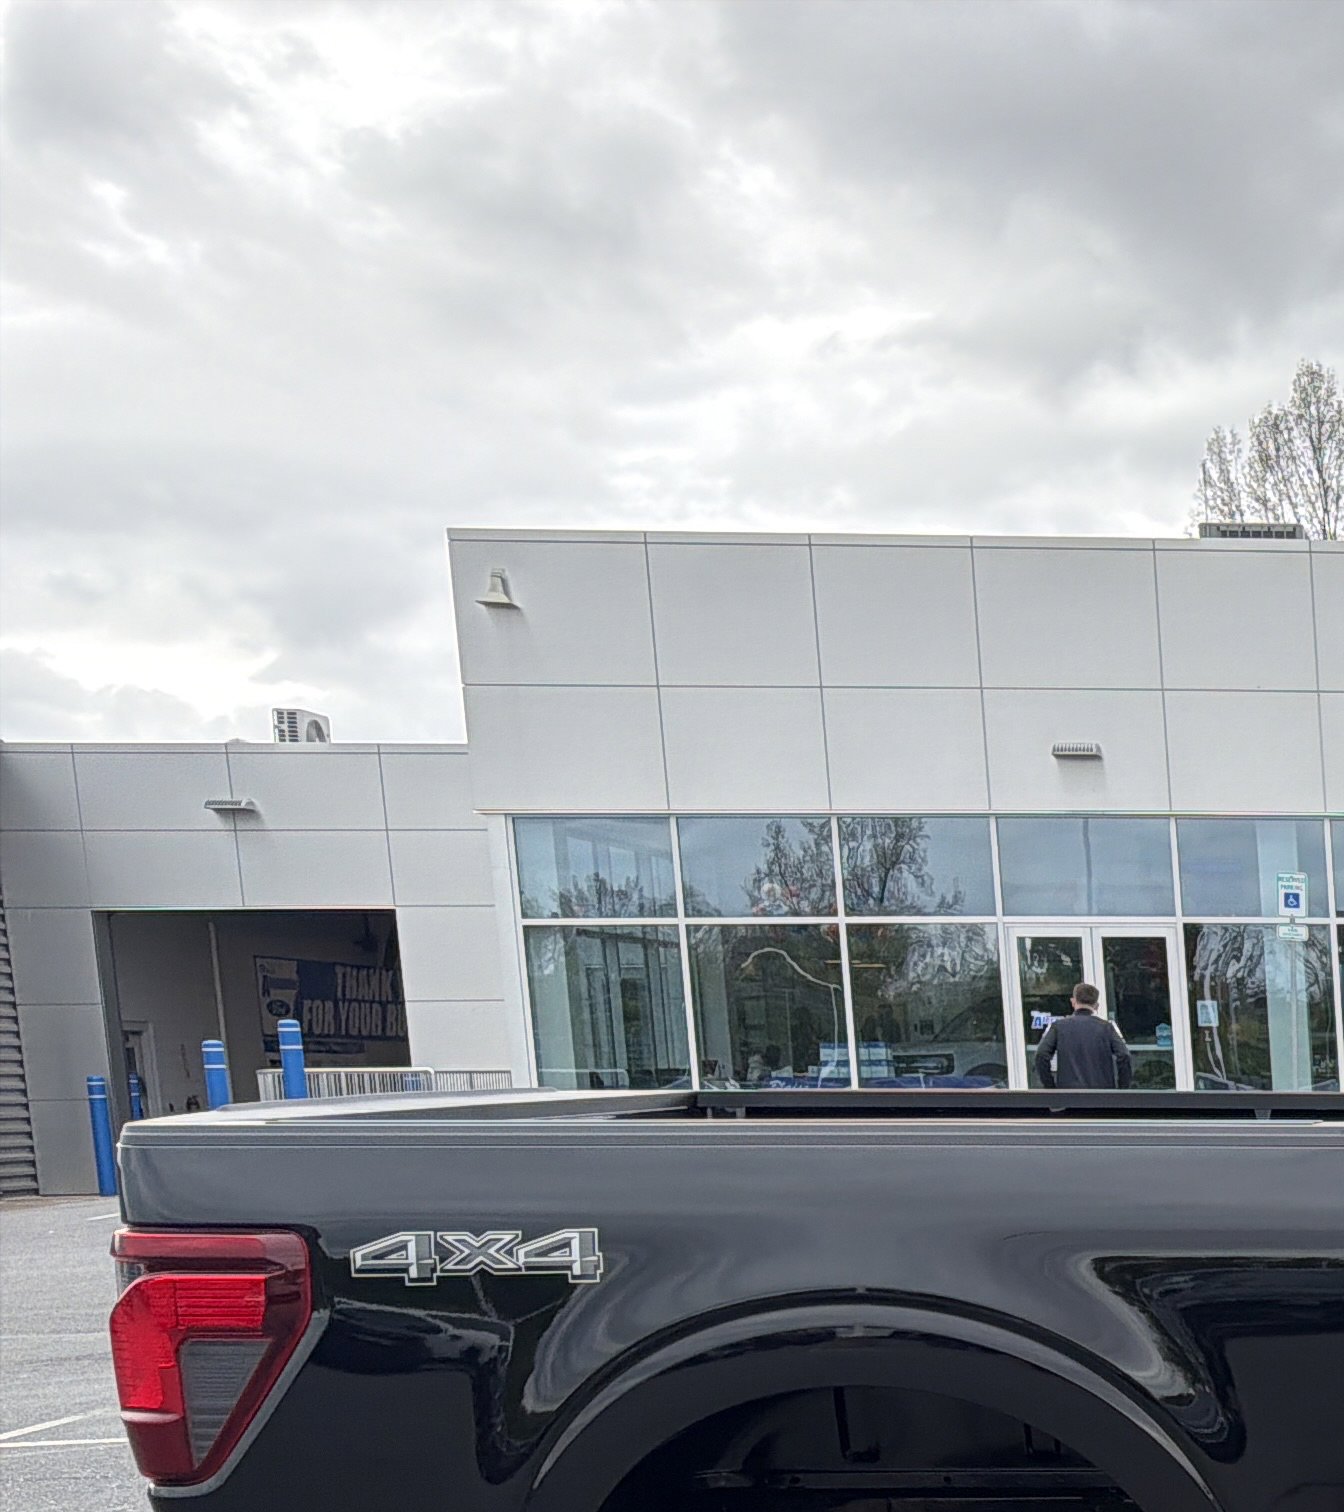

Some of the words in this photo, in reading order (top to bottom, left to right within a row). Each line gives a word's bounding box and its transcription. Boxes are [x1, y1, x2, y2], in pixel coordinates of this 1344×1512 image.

[335, 965, 393, 1000] THANK
[303, 999, 335, 1035] FOR
[338, 1001, 382, 1036] YOUR
